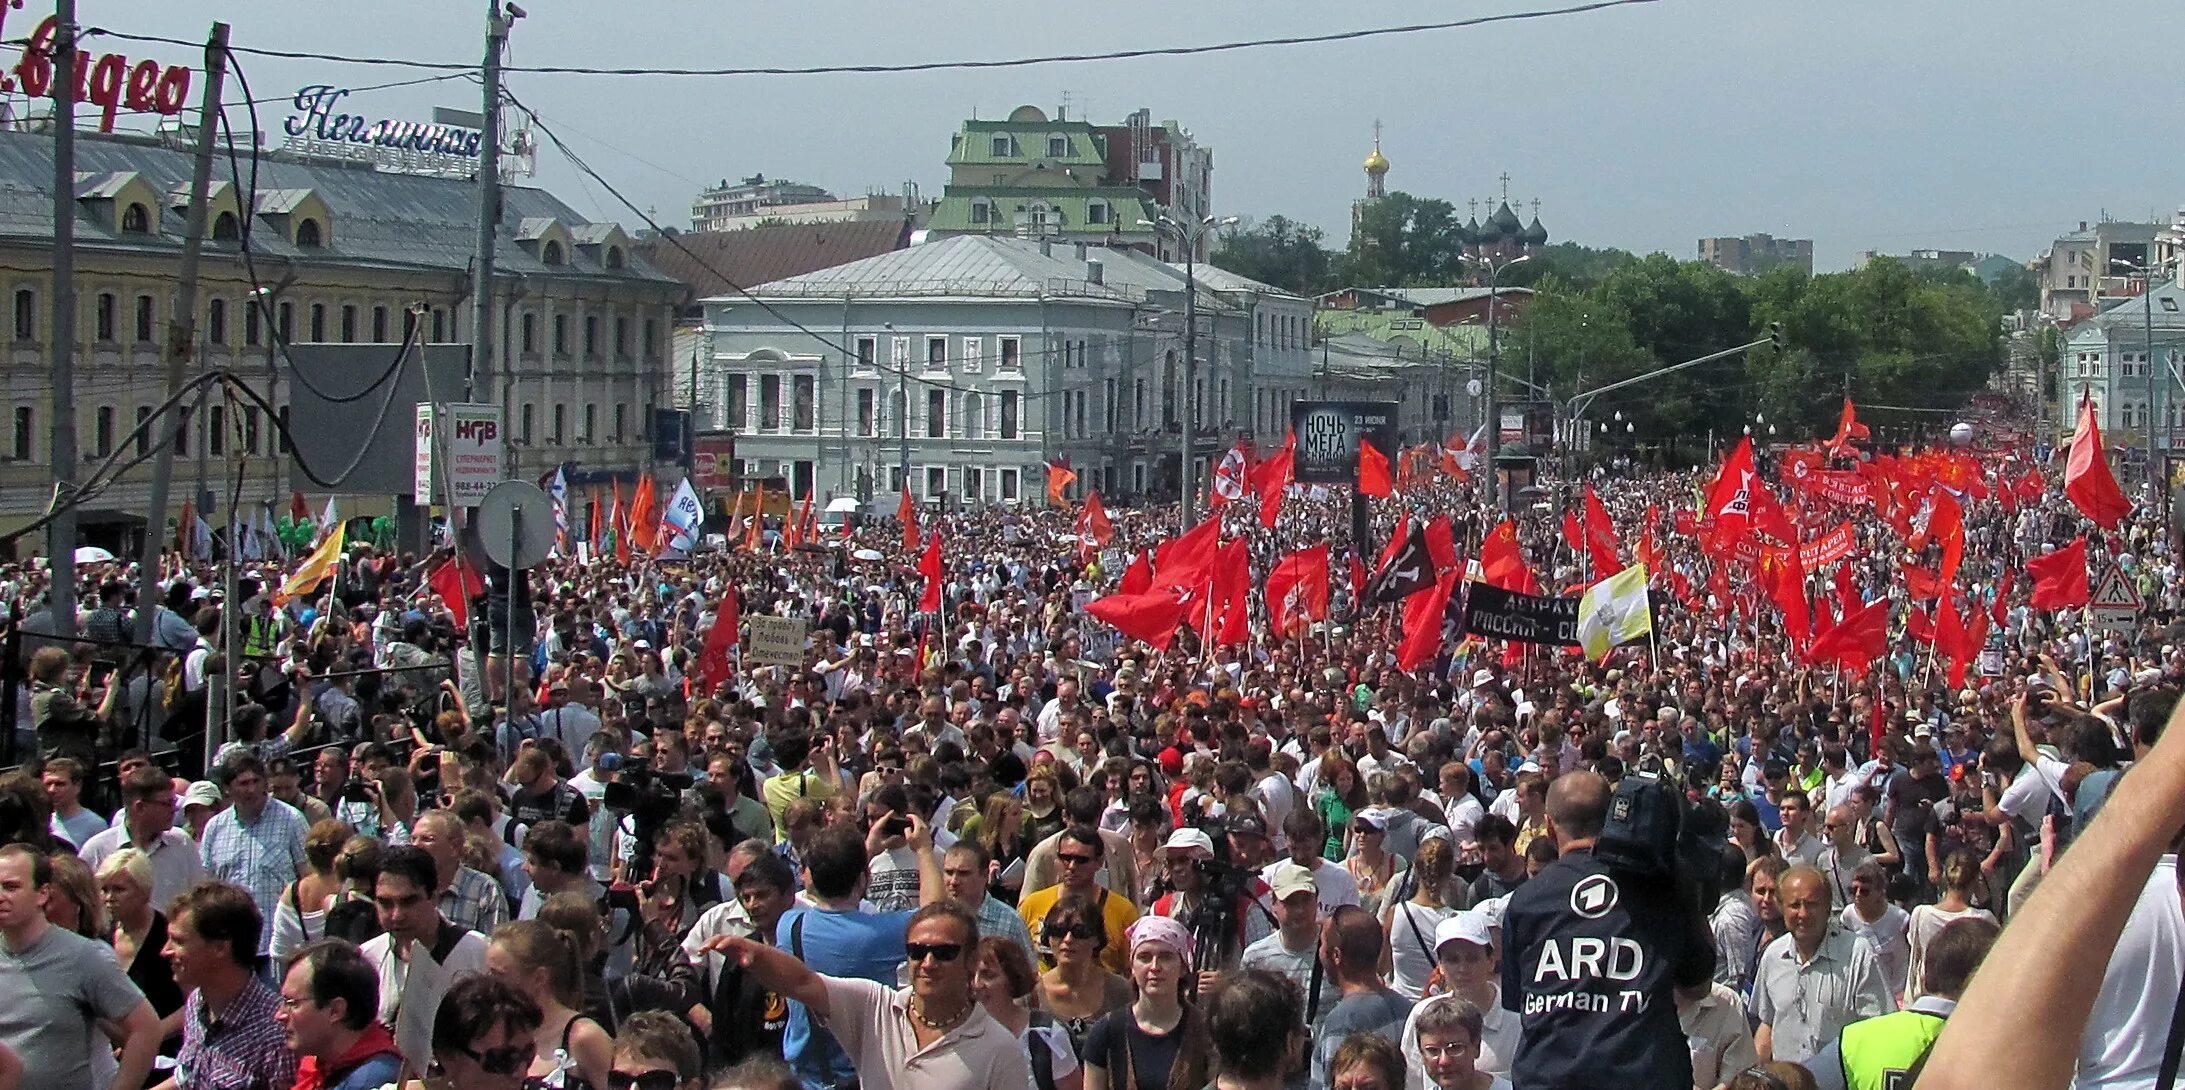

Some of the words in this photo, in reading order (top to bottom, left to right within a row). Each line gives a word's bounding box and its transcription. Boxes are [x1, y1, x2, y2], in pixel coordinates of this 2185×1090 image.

[1305, 415, 1346, 434] НОЧЬ
[1354, 415, 1363, 425] 23
[1305, 434, 1346, 452] МЕГА
[1534, 936, 1644, 983] ARD
[1525, 991, 1608, 1015] German
[1618, 990, 1651, 1014] TV
